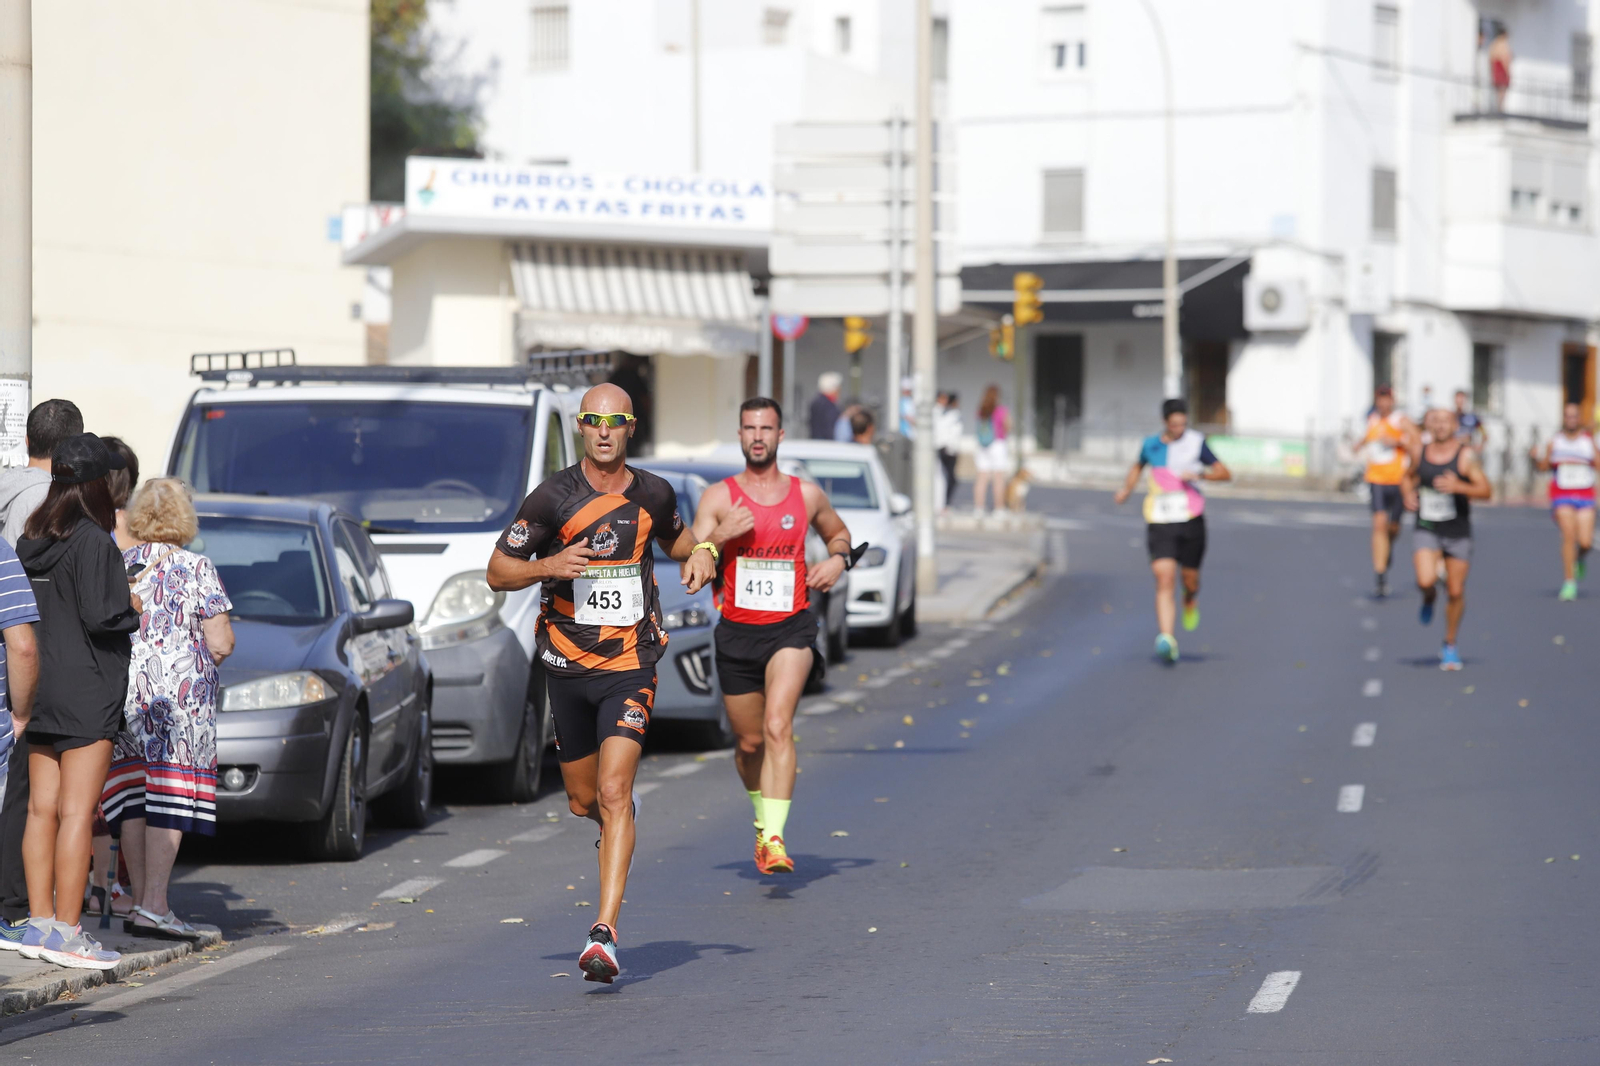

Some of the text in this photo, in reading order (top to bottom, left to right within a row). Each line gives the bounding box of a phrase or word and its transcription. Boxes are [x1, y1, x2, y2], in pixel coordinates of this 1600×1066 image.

[450, 168, 595, 191] CHURROS
[623, 176, 767, 198] CHOCOLA
[492, 196, 747, 221] PATATAS FRITAS
[737, 545, 796, 558] DOGFACE
[587, 569, 612, 578] VUELTA
[612, 569, 618, 578] A
[618, 567, 638, 577] HUELVA
[747, 561, 767, 570] VUELTA
[772, 562, 791, 570] HUELVA
[746, 580, 773, 596] 413
[586, 590, 622, 610] 453
[542, 650, 568, 668] HUELVA
